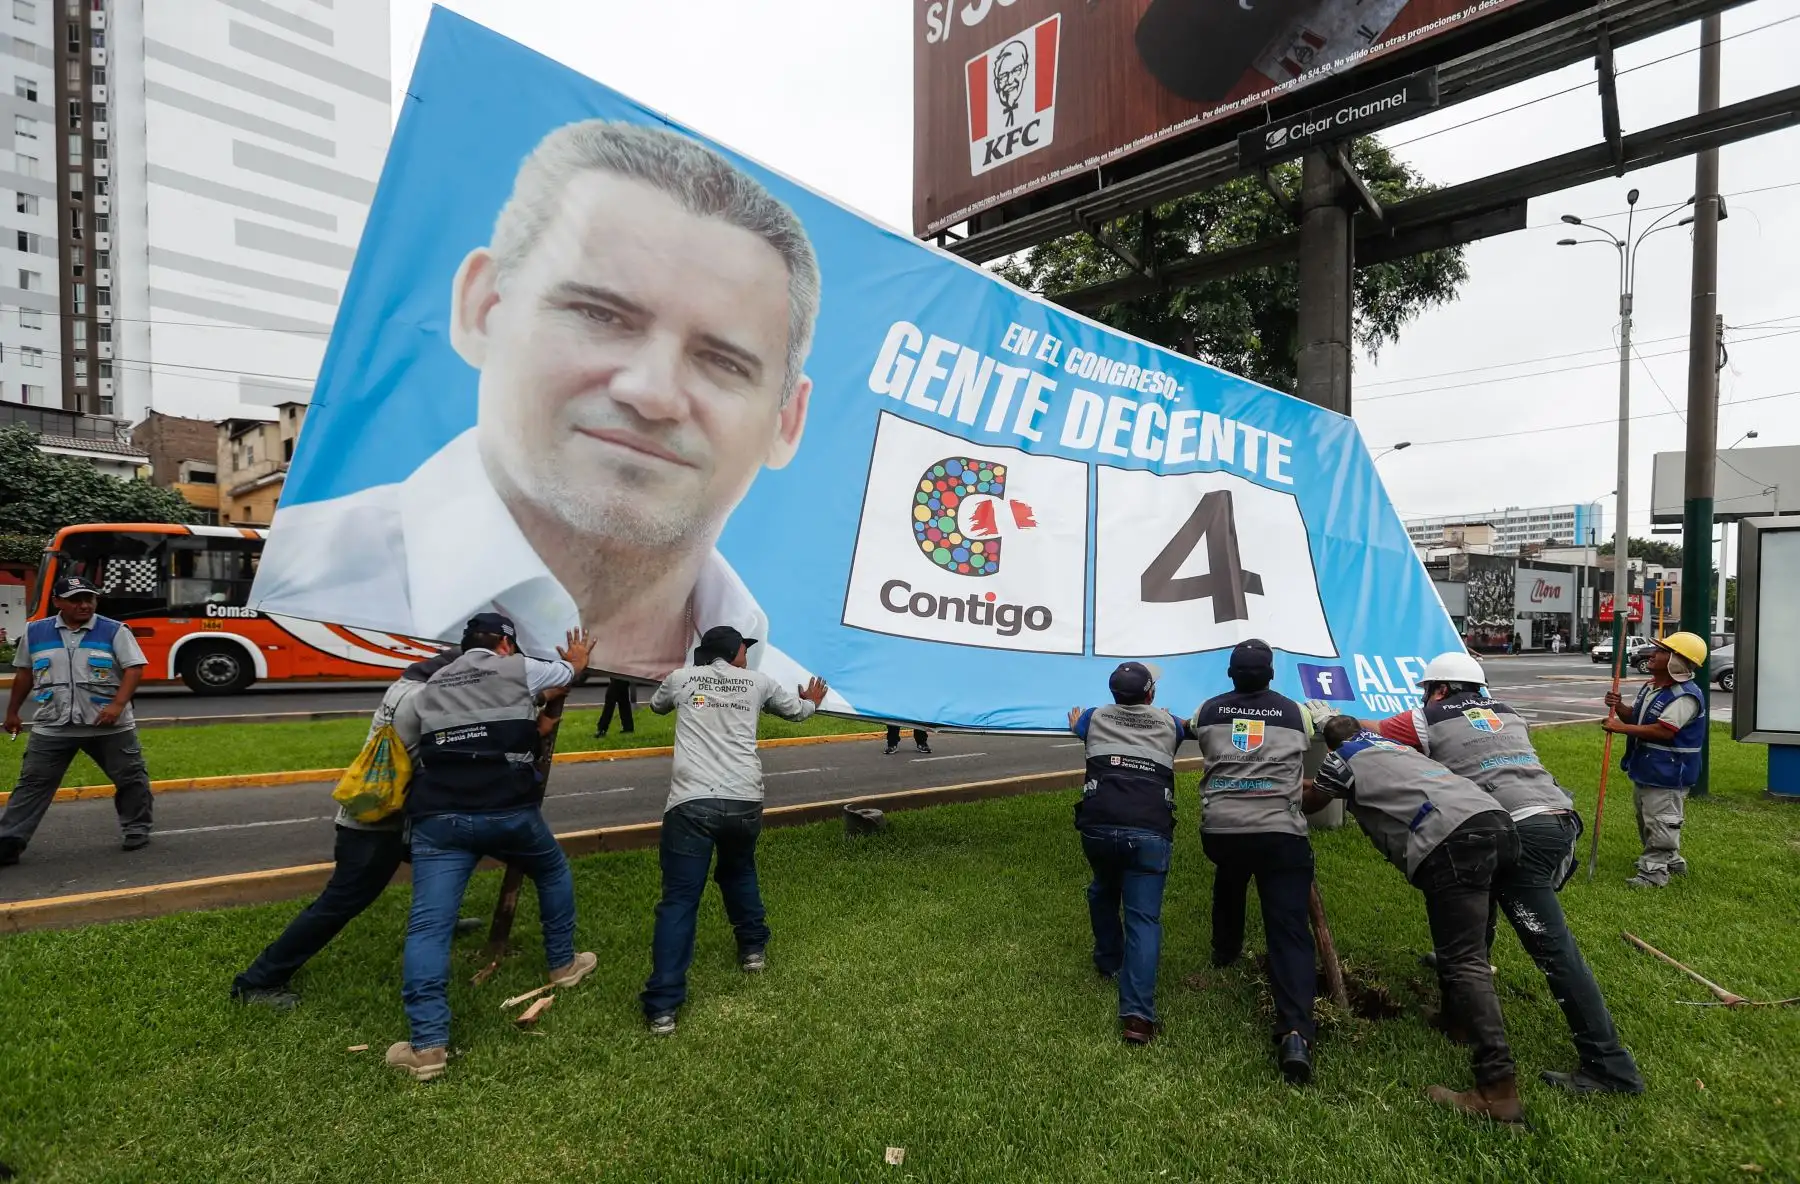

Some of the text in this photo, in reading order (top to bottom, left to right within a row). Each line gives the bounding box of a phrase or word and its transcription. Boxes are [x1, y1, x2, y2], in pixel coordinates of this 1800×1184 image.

[1101, 151, 1108, 160] en
[1108, 145, 1123, 159] todas
[1124, 141, 1132, 151] las
[1133, 133, 1153, 148] tiendas
[1158, 124, 1172, 136] nivel
[1173, 114, 1201, 131] nacional.
[1202, 109, 1213, 120] Por
[1214, 97, 1240, 114] delivery
[1240, 91, 1260, 106] aplica
[1261, 87, 1270, 98] un
[1271, 78, 1297, 94] recargo
[1298, 71, 1307, 82] de
[1334, 58, 1344, 67] No
[1345, 46, 1369, 63] válido
[1369, 42, 1384, 54] con
[1385, 32, 1407, 48] otras
[1407, 11, 1461, 41] promociones
[1462, 5, 1477, 19] y/o
[1289, 88, 1407, 140] Clear Channel
[983, 119, 1040, 166] KFC
[1000, 322, 1185, 403] EN EL CONGRESO:
[868, 321, 1294, 485] GENTE DECENTE
[1140, 489, 1265, 625] 4
[206, 603, 258, 618] Comas
[879, 579, 1053, 637] Contigo
[689, 676, 754, 687] MANTENIMIENTO
[698, 683, 748, 693] DEL ORNATO
[1361, 693, 1404, 713] VON
[1218, 706, 1283, 717] FISCALIZACIÓN
